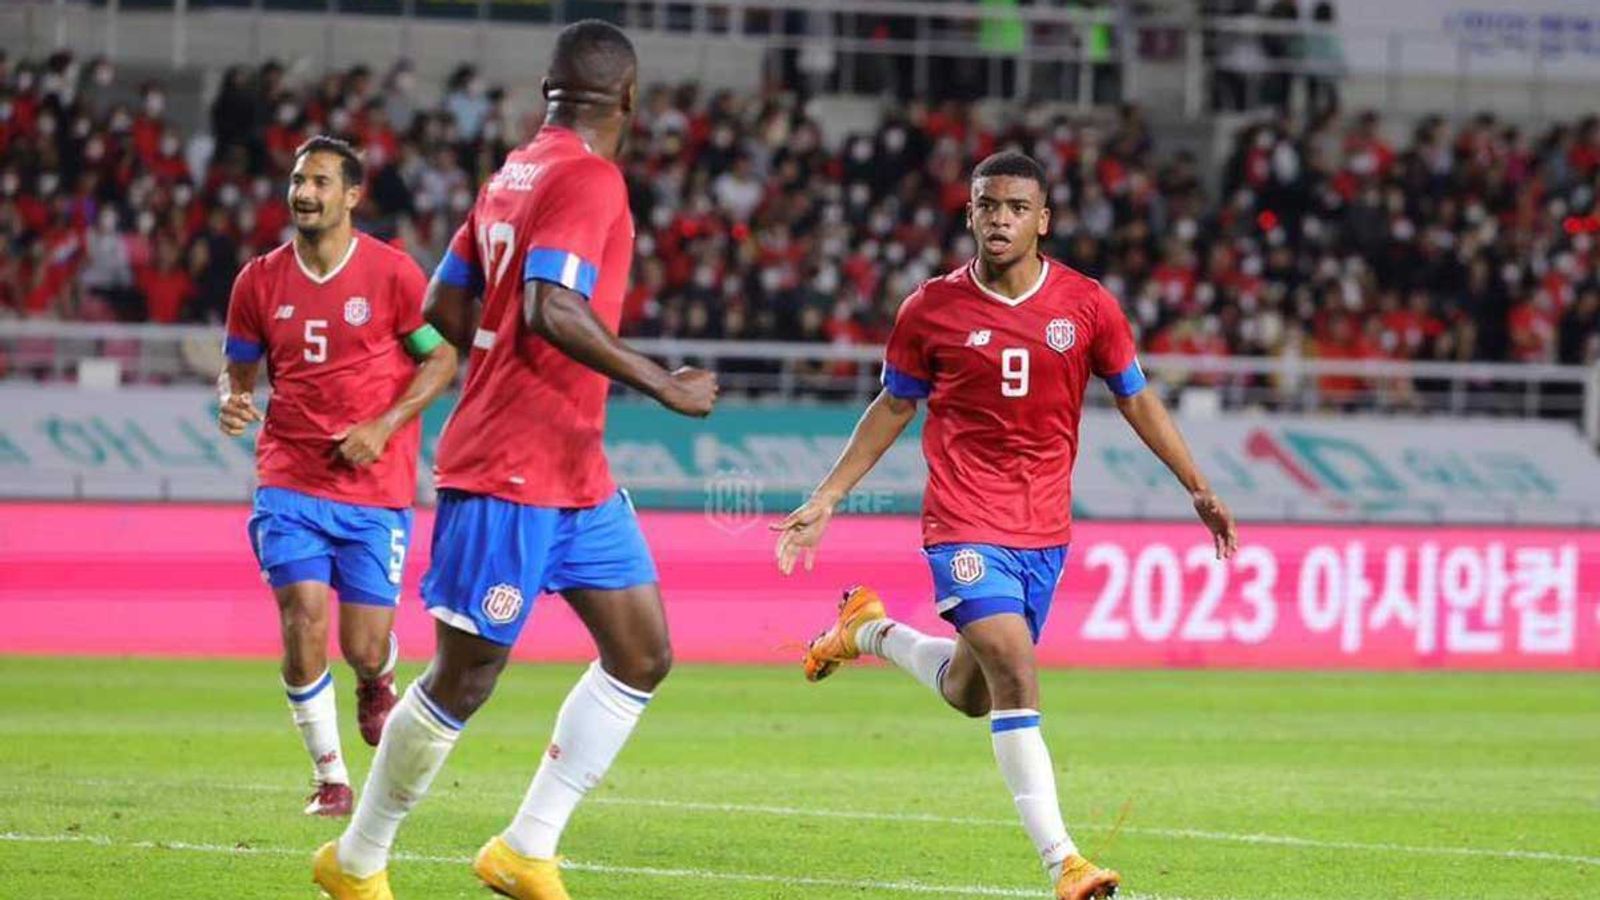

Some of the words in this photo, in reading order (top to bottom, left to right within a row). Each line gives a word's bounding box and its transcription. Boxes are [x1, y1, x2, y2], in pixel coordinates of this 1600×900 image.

[303, 319, 329, 364] 5
[1001, 347, 1030, 398] 9
[389, 528, 406, 574] 5
[489, 590, 515, 615] CR
[1080, 543, 1279, 643] 2023
[1300, 541, 1579, 654] 아시안컵
